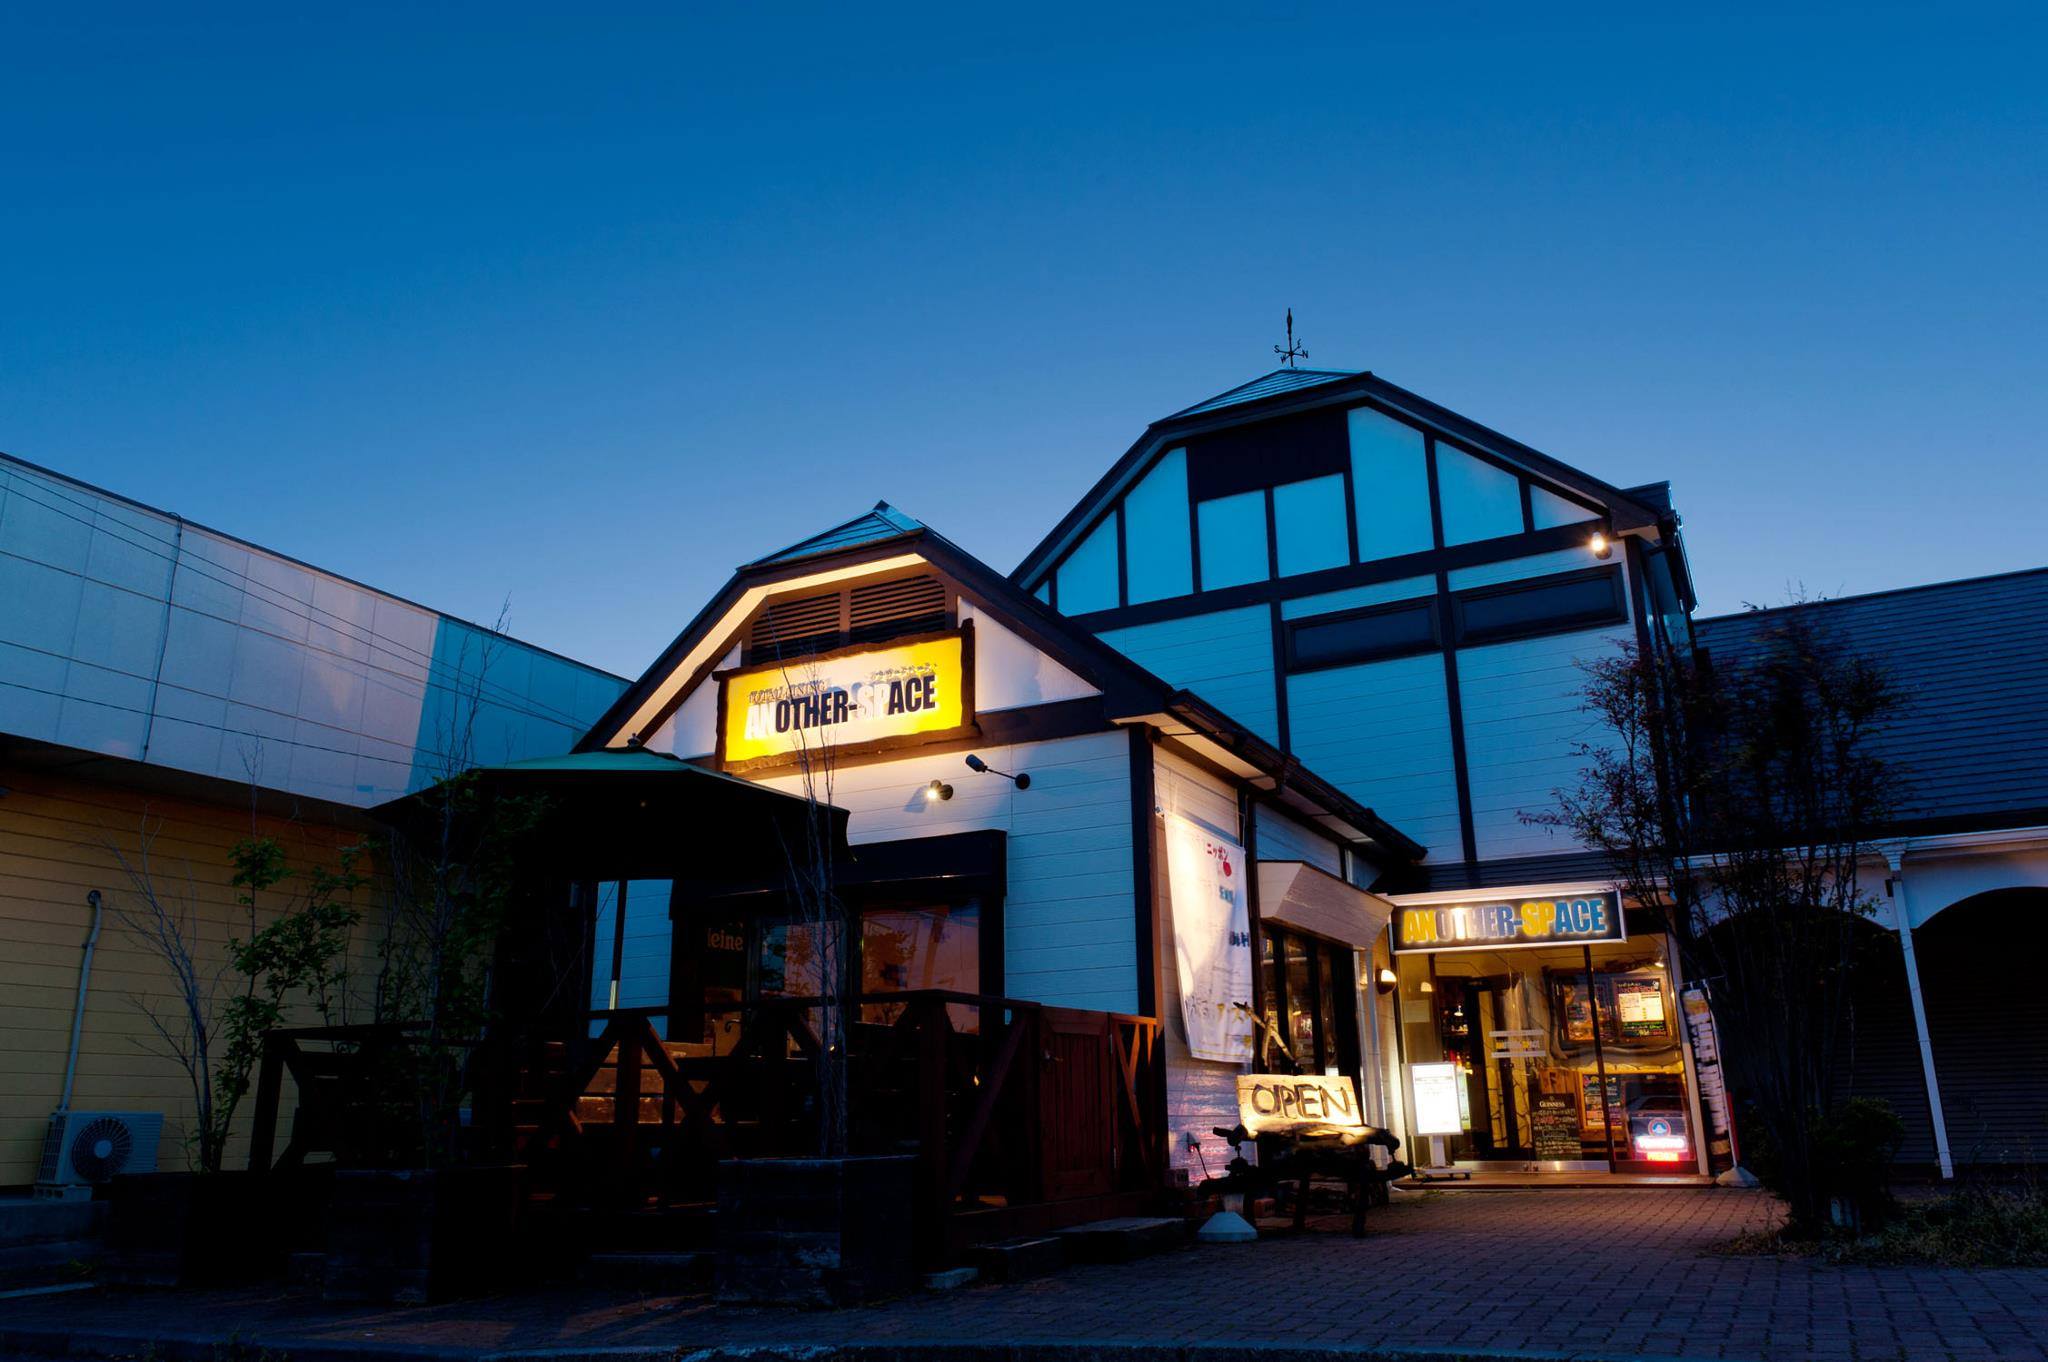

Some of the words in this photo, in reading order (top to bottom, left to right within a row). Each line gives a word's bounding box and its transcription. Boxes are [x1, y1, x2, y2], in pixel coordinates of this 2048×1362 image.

[746, 675, 936, 739] ANOTHER-SPACE
[1403, 899, 1606, 943] ANOTHER-SPACE
[1251, 1083, 1352, 1119] OPEN
